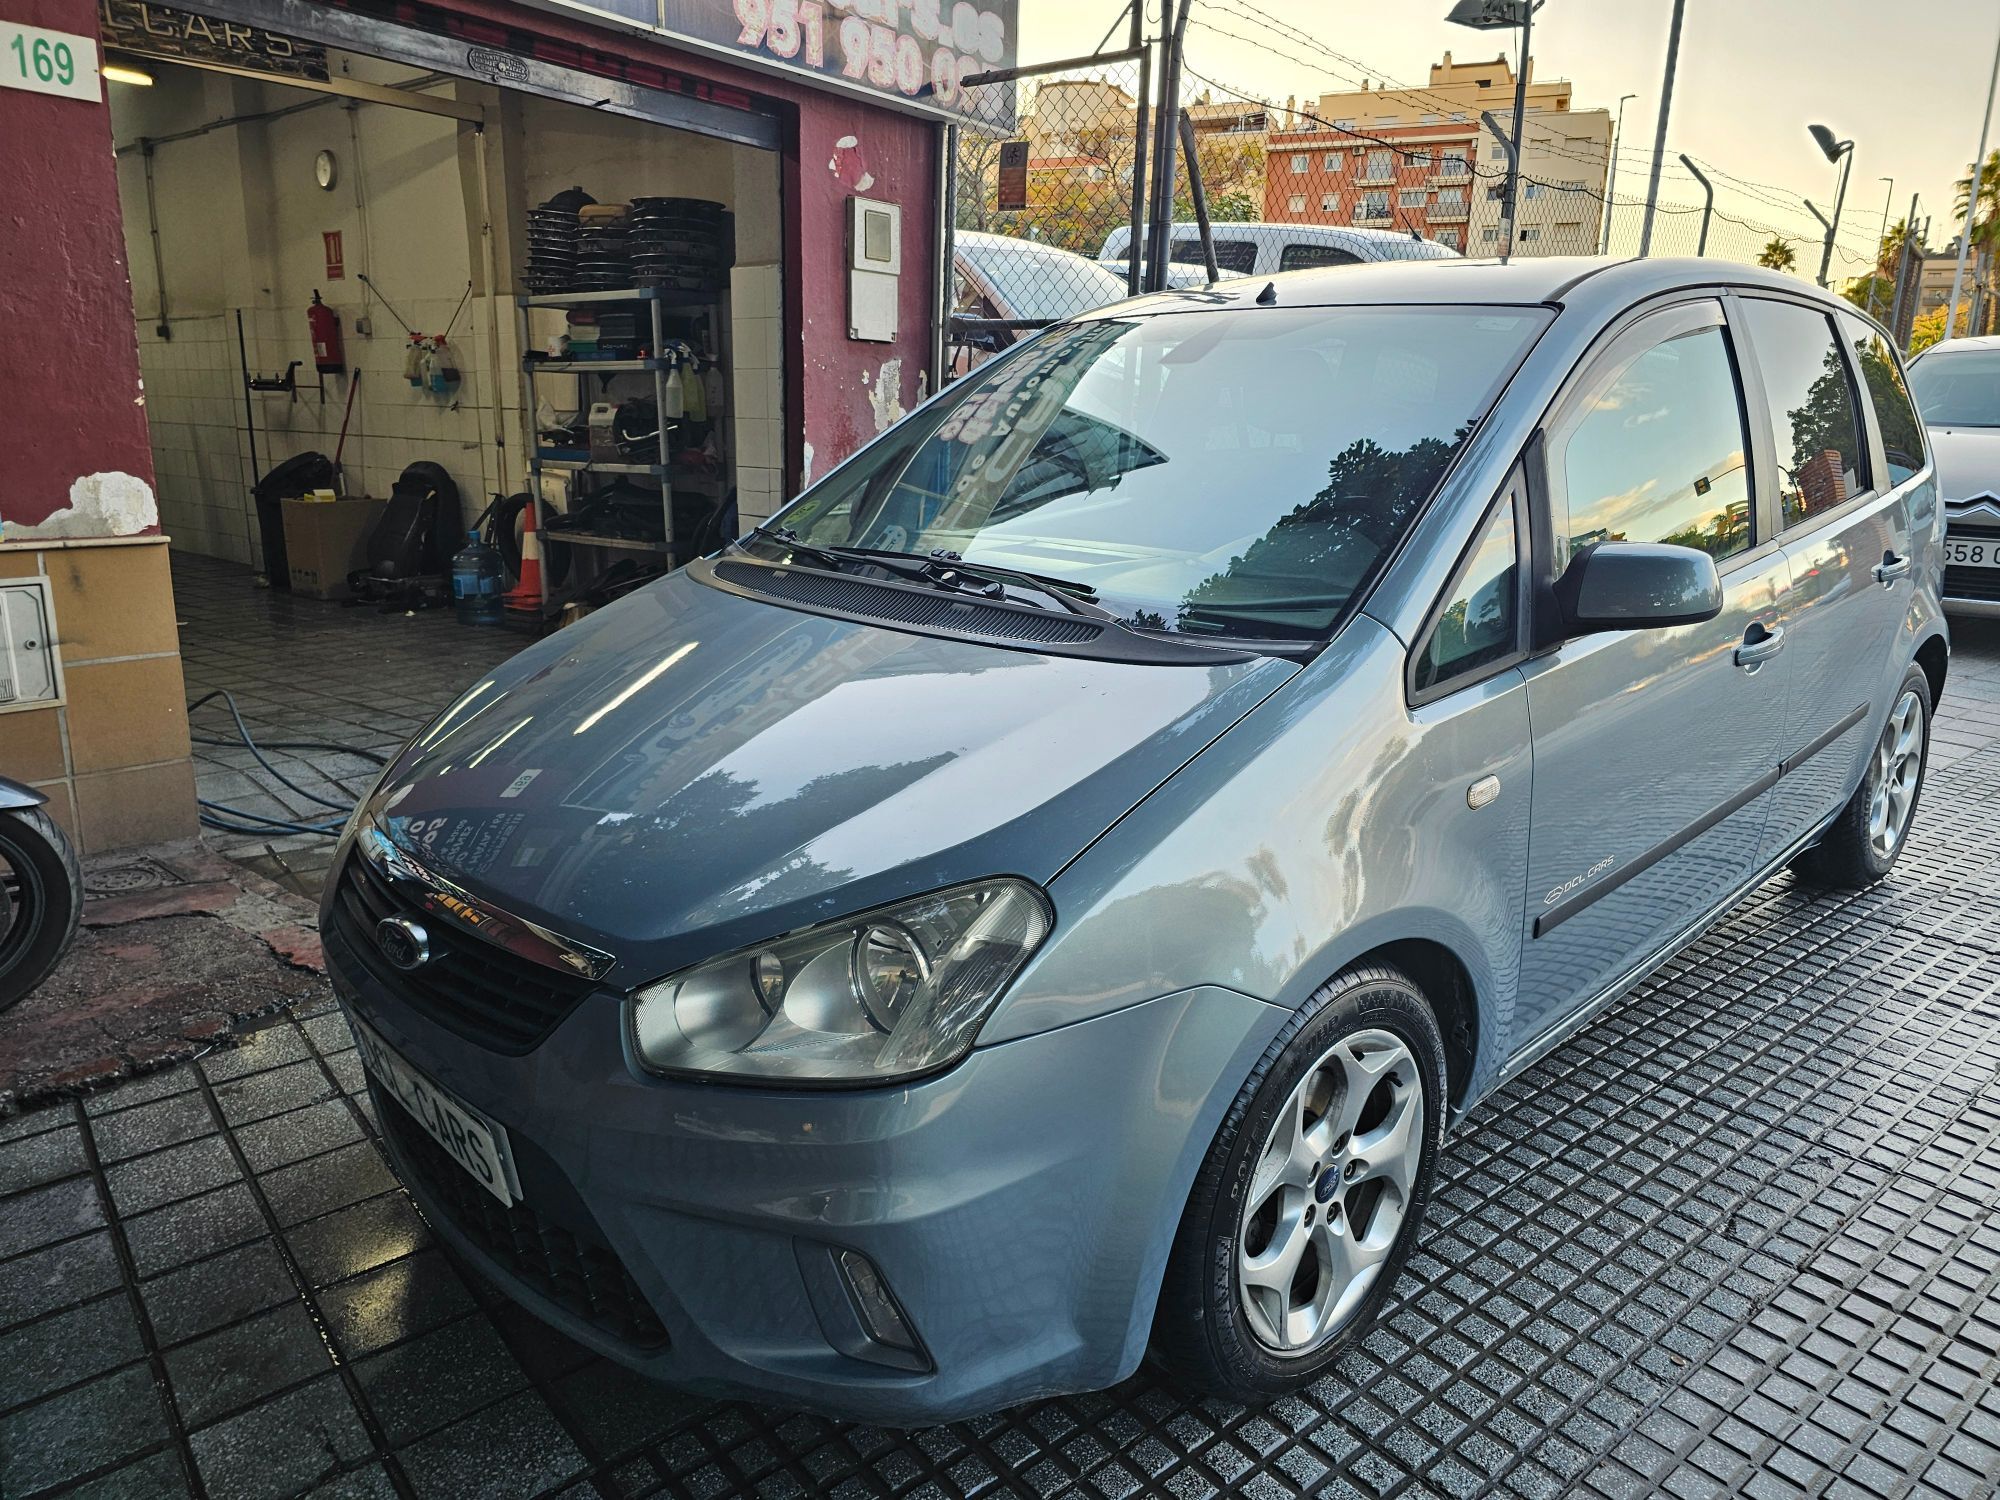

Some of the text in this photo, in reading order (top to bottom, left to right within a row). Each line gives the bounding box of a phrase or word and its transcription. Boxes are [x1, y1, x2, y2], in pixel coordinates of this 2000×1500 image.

[11, 34, 74, 86] 169
[734, 0, 824, 68] 951
[840, 15, 923, 96] 950
[1564, 855, 1614, 893] DCL CARS
[381, 937, 407, 961] Ford
[413, 1081, 494, 1184] CARS
